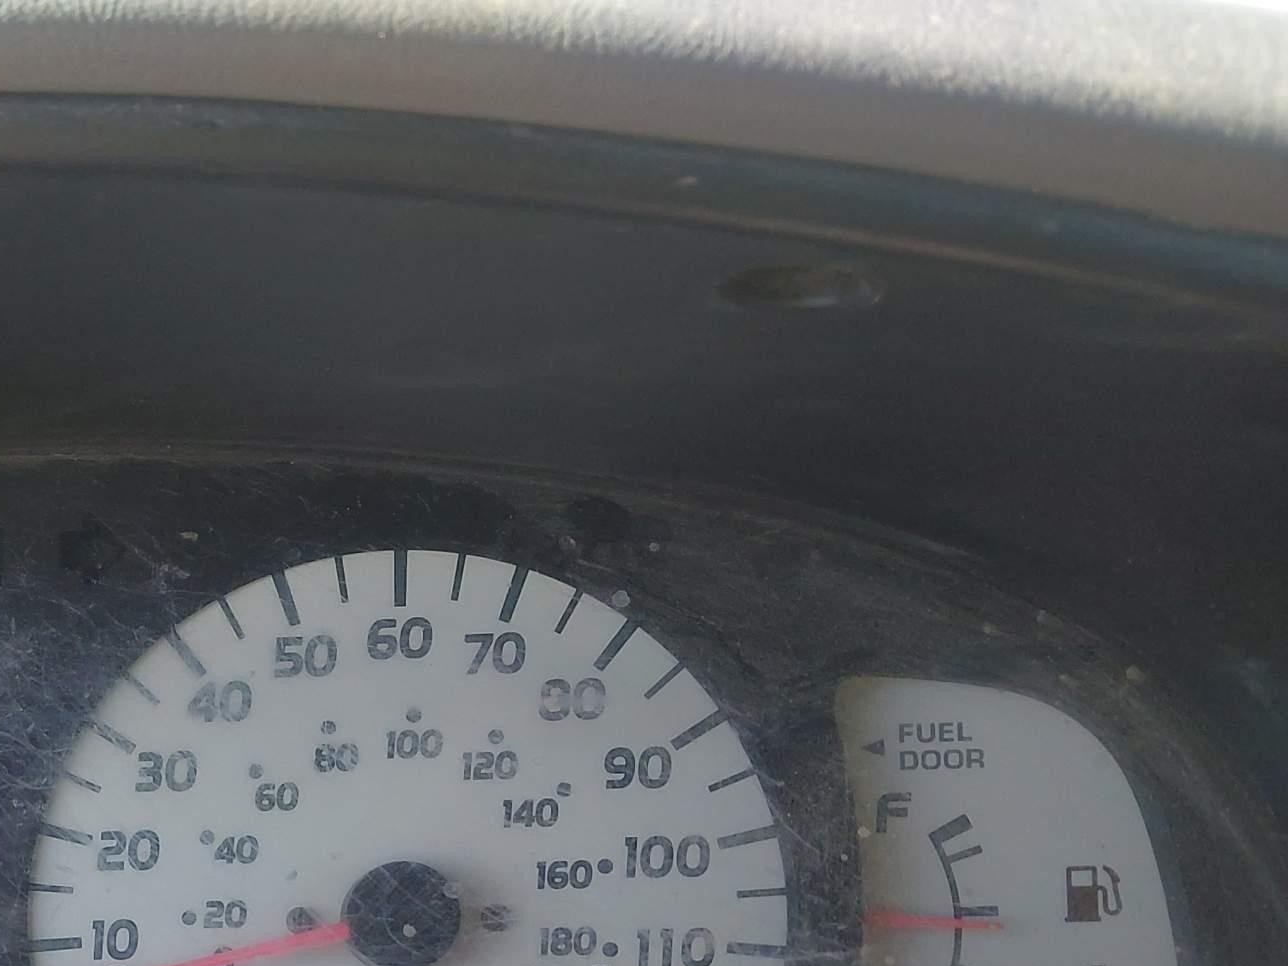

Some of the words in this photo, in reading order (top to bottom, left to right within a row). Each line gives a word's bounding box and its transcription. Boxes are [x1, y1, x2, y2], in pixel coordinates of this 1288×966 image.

[273, 634, 338, 678] 50
[367, 617, 433, 660] 60
[464, 632, 527, 674] 70
[187, 680, 253, 723] 40
[538, 677, 607, 721] 80
[386, 728, 444, 760] 100
[898, 722, 973, 744] FUEL
[135, 750, 198, 792] 30
[314, 743, 360, 773] 80
[462, 750, 519, 781] 120
[604, 746, 672, 790] 90
[899, 749, 985, 771] DOOR
[255, 782, 300, 812] 60
[503, 798, 559, 828] 140
[876, 792, 912, 834] F
[97, 830, 160, 872] 20
[214, 835, 260, 864] 40
[625, 835, 711, 879] 100
[537, 860, 593, 890] 160
[203, 900, 248, 929] 20
[92, 919, 139, 960] 10
[540, 927, 597, 956] 180
